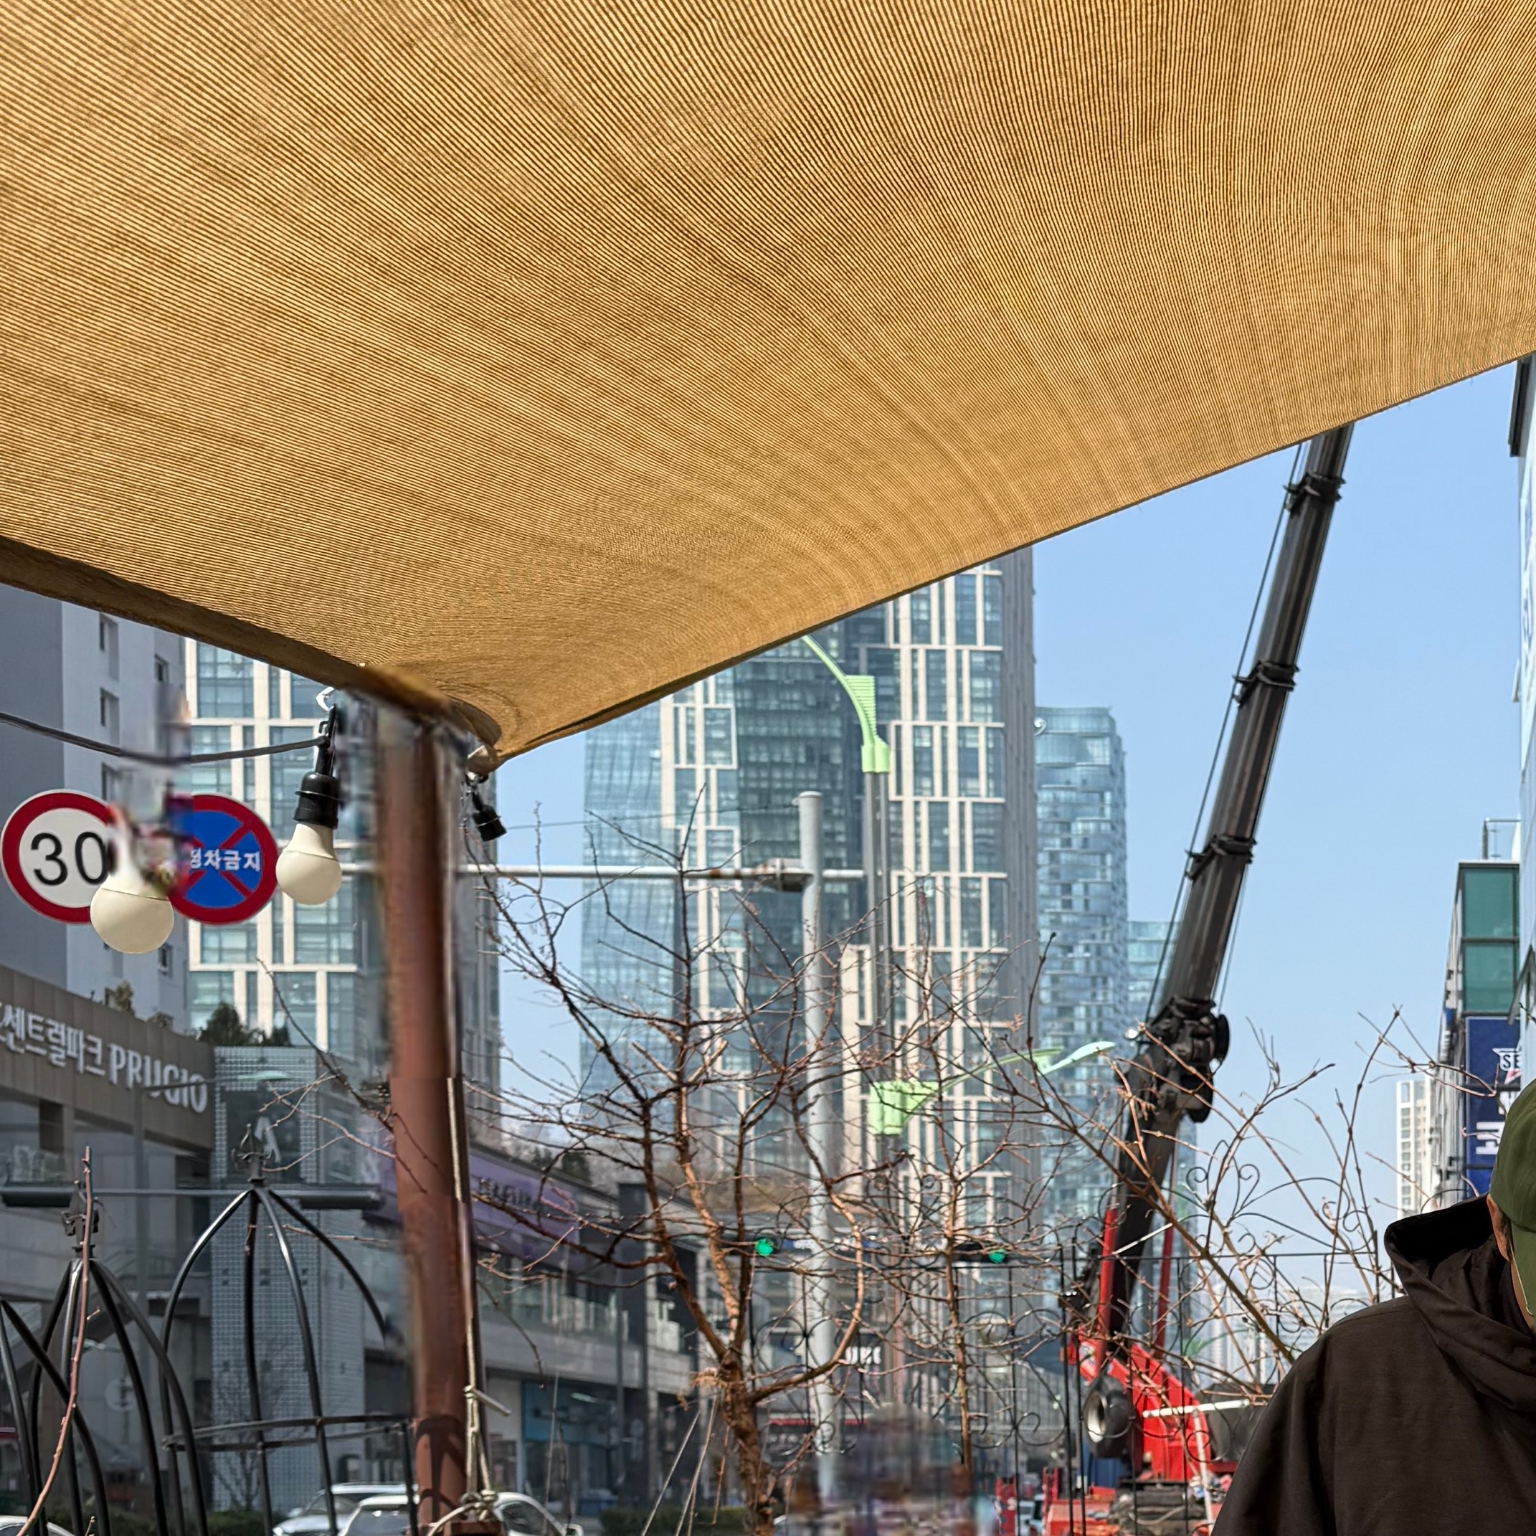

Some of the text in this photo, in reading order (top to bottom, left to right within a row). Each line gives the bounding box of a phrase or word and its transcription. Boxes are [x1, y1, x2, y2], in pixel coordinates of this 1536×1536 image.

[31, 831, 114, 885] 30
[0, 1002, 208, 1113] 센트럴파크 PRUGIO
